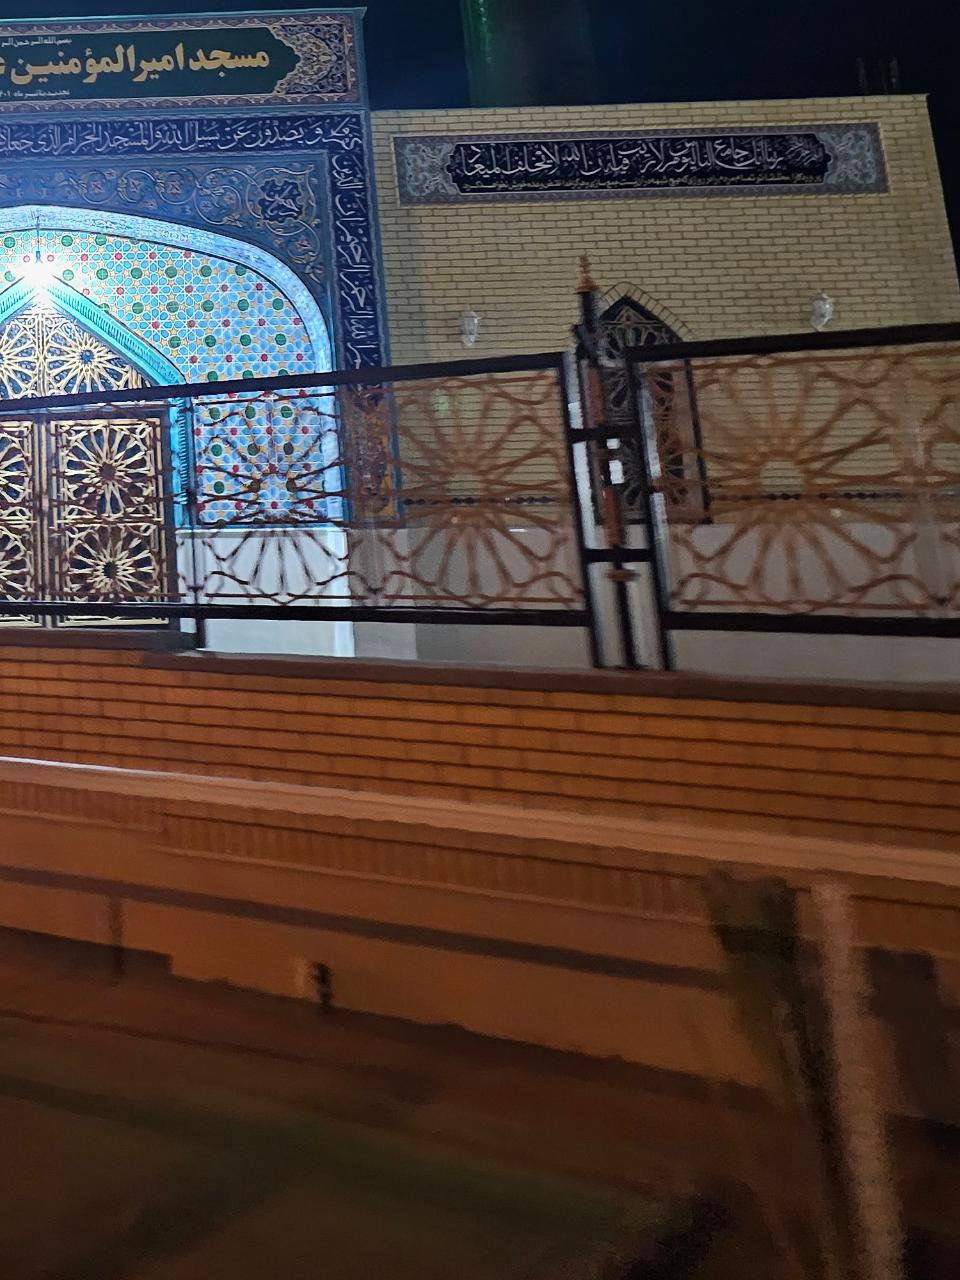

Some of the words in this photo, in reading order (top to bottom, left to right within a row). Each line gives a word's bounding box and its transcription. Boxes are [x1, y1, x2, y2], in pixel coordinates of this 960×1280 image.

[10, 43, 136, 85] المؤمنین
[132, 42, 185, 82] امیر
[189, 48, 270, 78] مسجد
